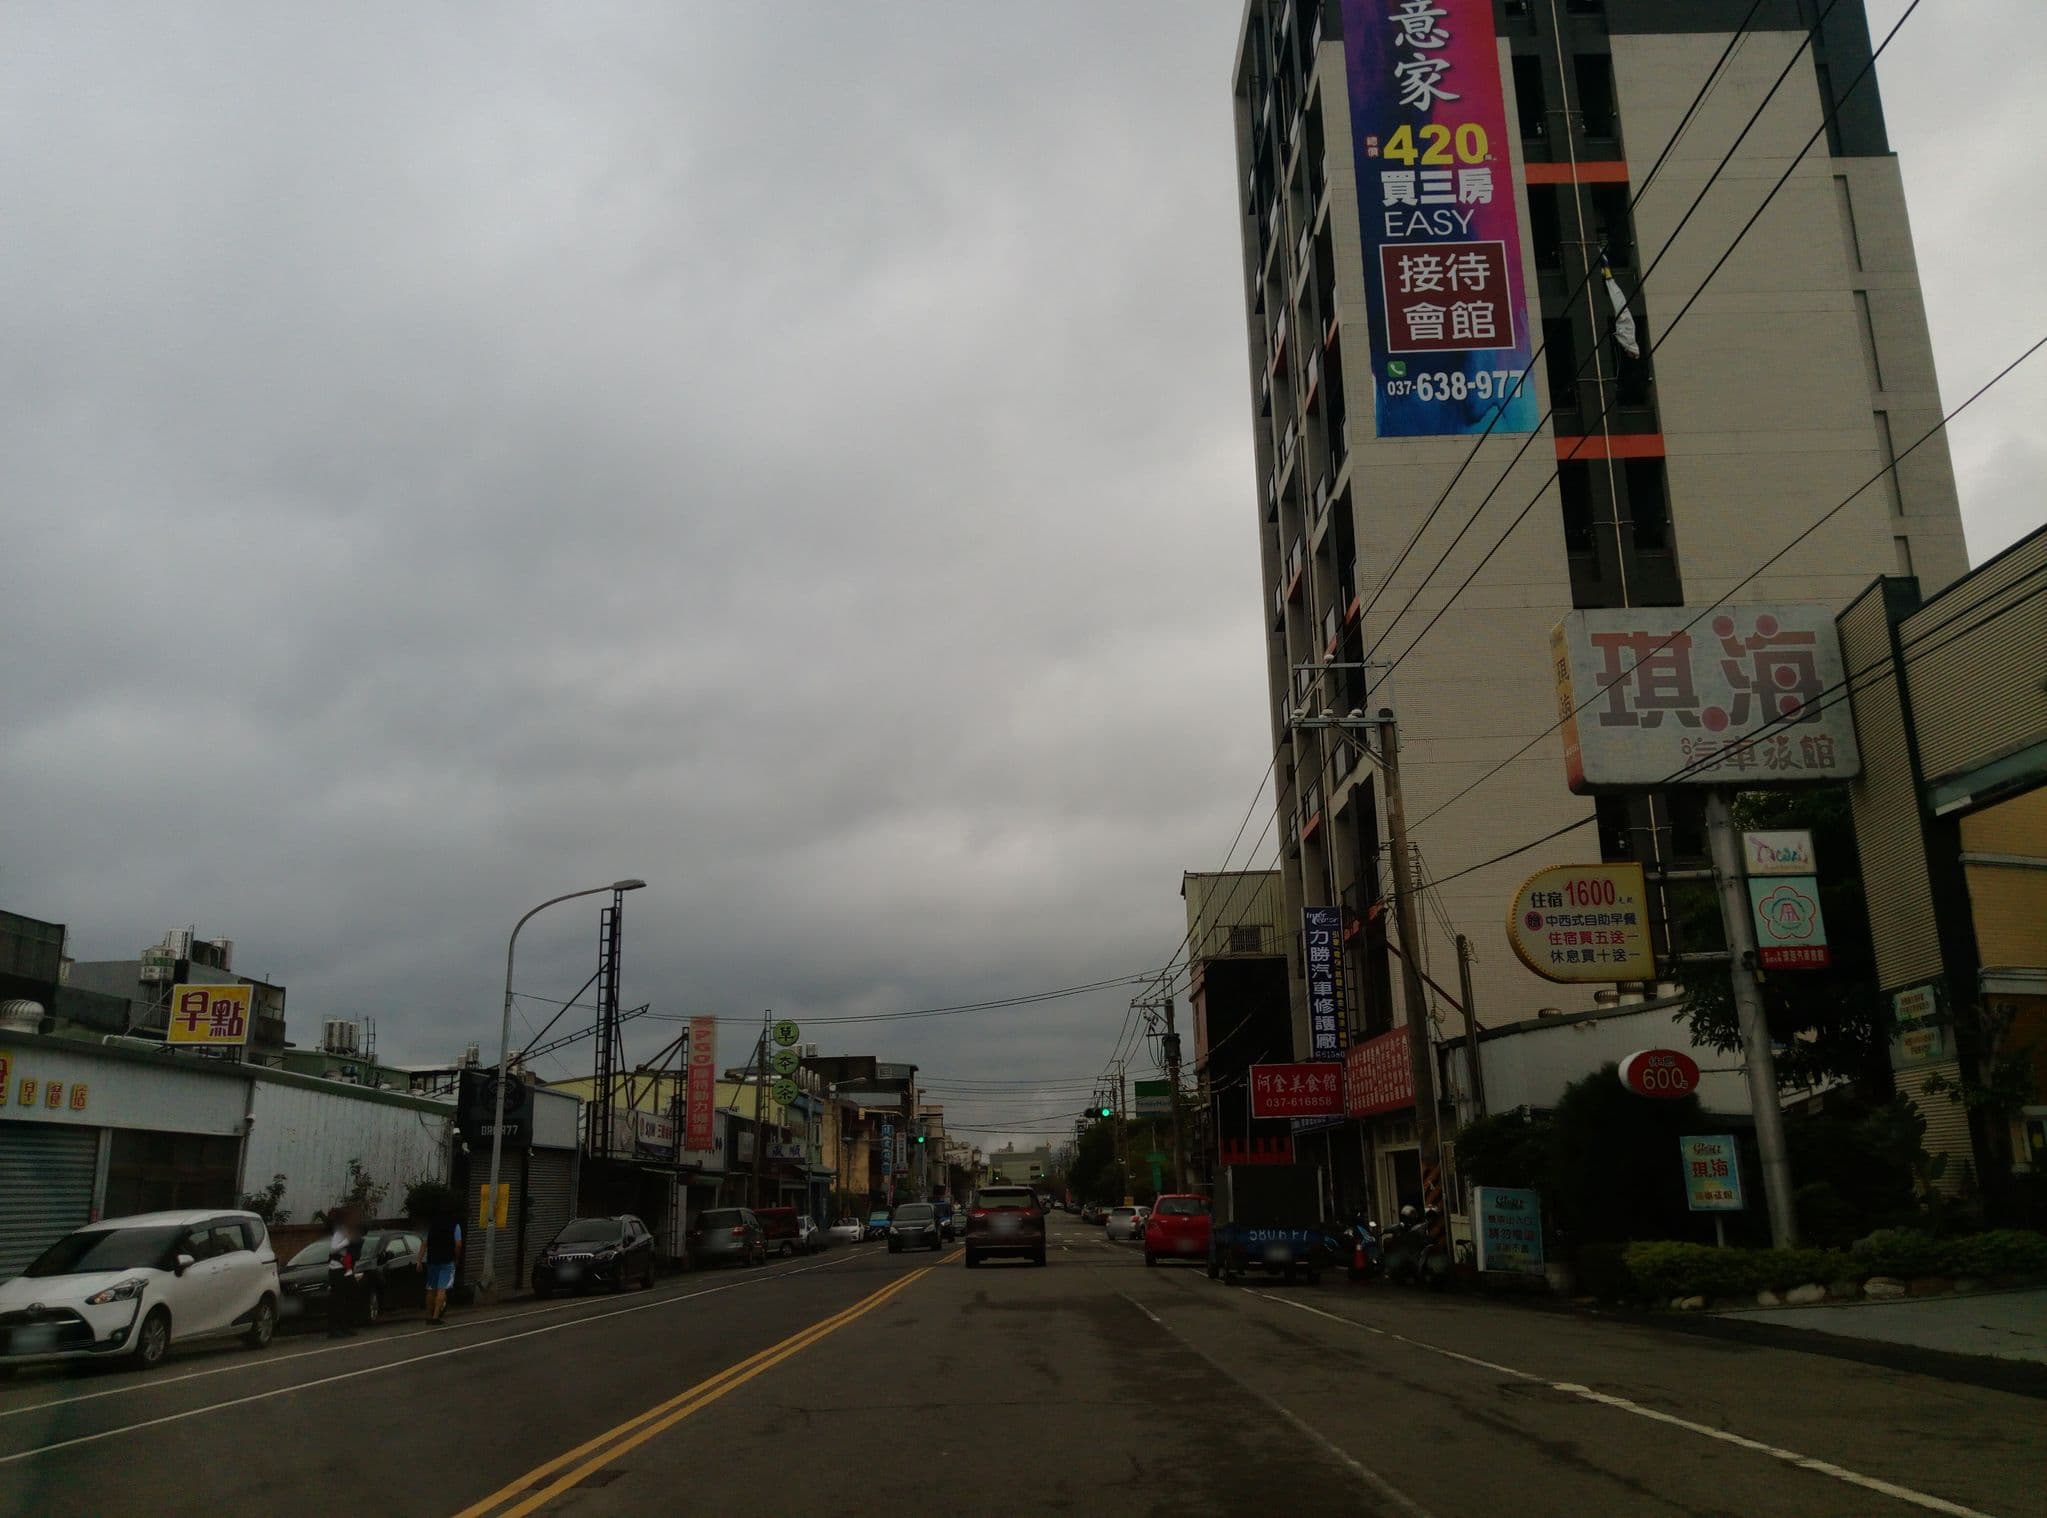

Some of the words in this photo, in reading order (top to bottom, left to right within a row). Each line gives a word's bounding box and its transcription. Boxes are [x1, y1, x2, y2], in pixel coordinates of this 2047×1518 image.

[1383, 122, 1489, 166] 420
[1380, 167, 1494, 207] 買三房
[1384, 208, 1474, 237] EASY
[1398, 252, 1491, 293] 接待
[1402, 300, 1496, 341] 會館
[1387, 369, 1526, 401] 037-638-977
[1591, 614, 1824, 732] 琪海
[1682, 734, 1836, 771] 汽車旅館
[1531, 891, 1562, 908] 住宿
[1564, 879, 1616, 906] 1600
[1546, 912, 1636, 927] 中西式自助早餐
[1548, 930, 1639, 945] 住宿買五送一
[1551, 948, 1640, 963] 休息買十送一
[1309, 929, 1337, 1049] 力勝汽車修護廠
[175, 991, 245, 1037] 早點
[1642, 1067, 1684, 1090] 600
